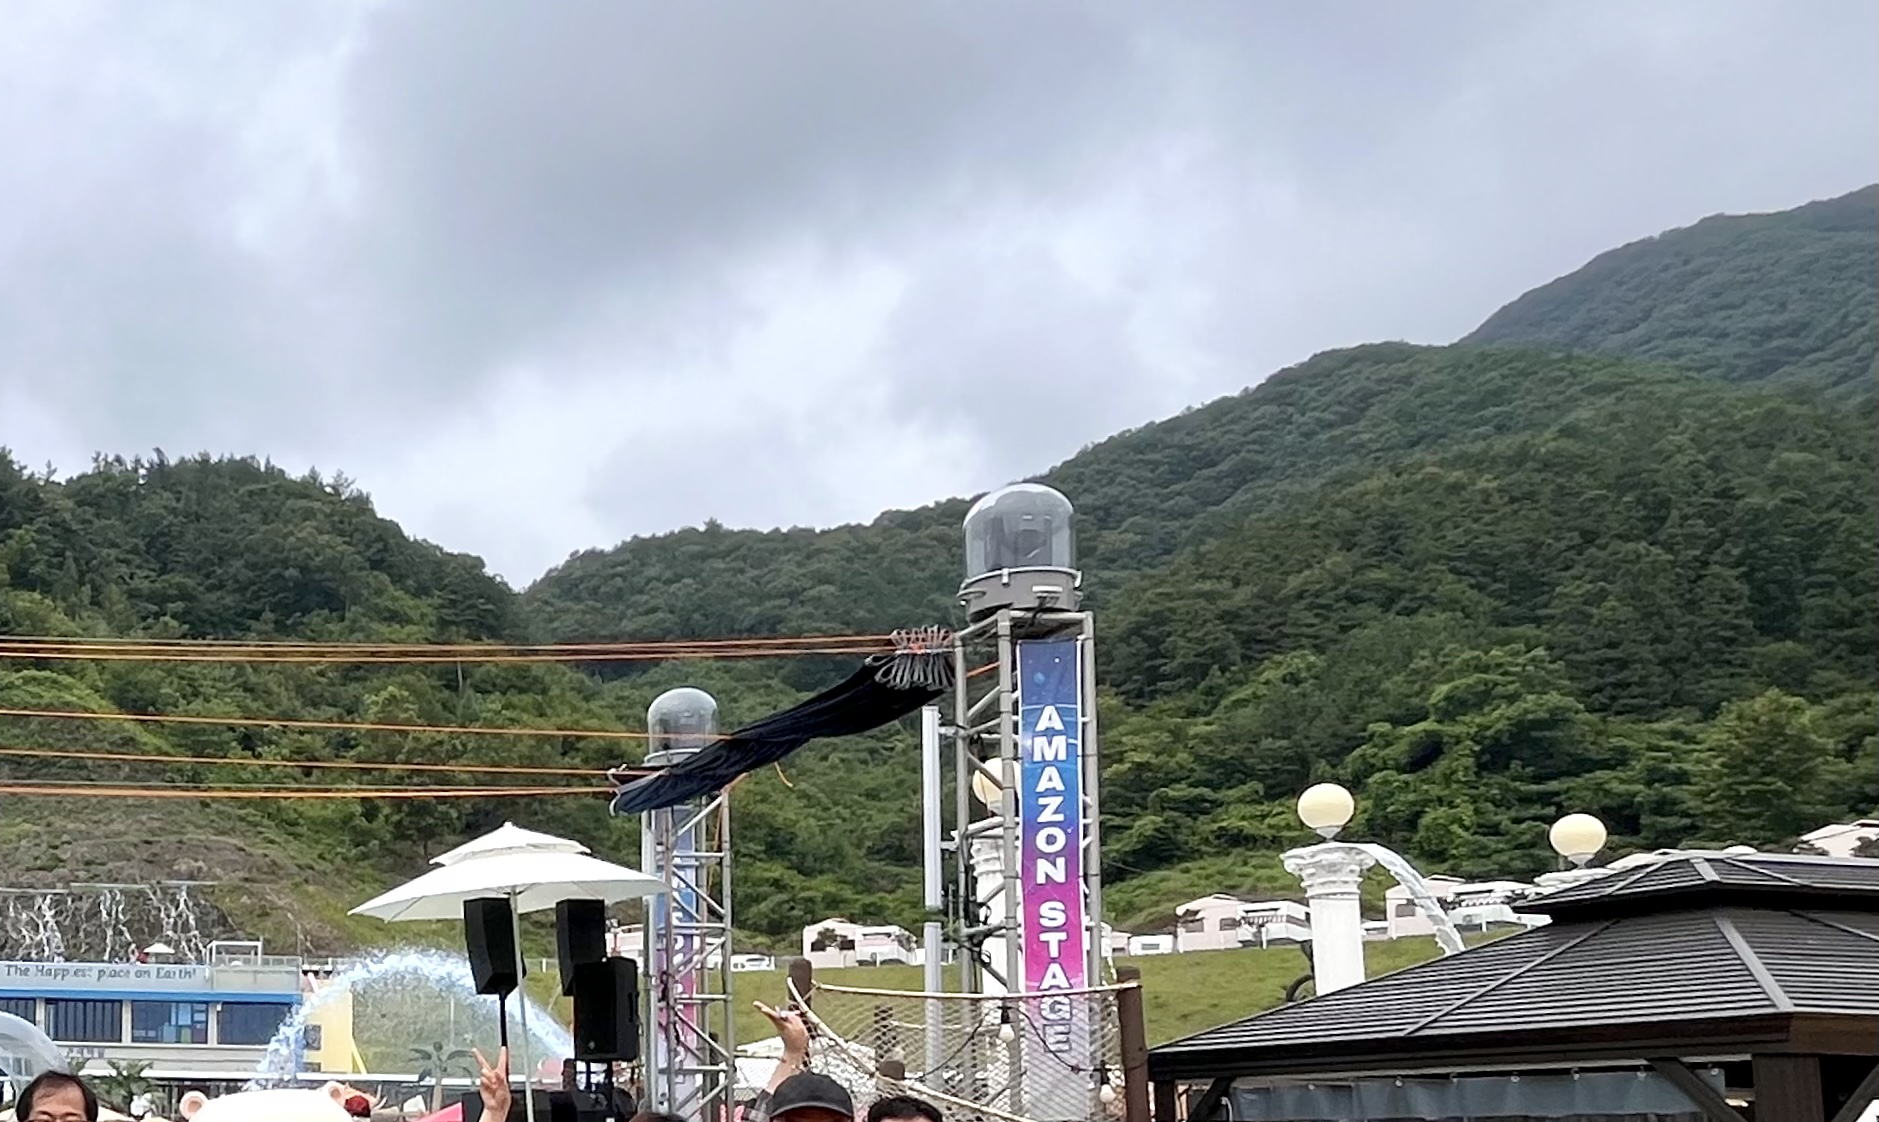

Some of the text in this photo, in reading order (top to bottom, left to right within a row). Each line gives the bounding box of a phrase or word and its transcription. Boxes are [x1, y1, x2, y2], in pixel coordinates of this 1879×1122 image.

[1032, 705, 1072, 1053] AMAZON STAGE
[5, 964, 31, 977] The
[135, 968, 151, 979] on
